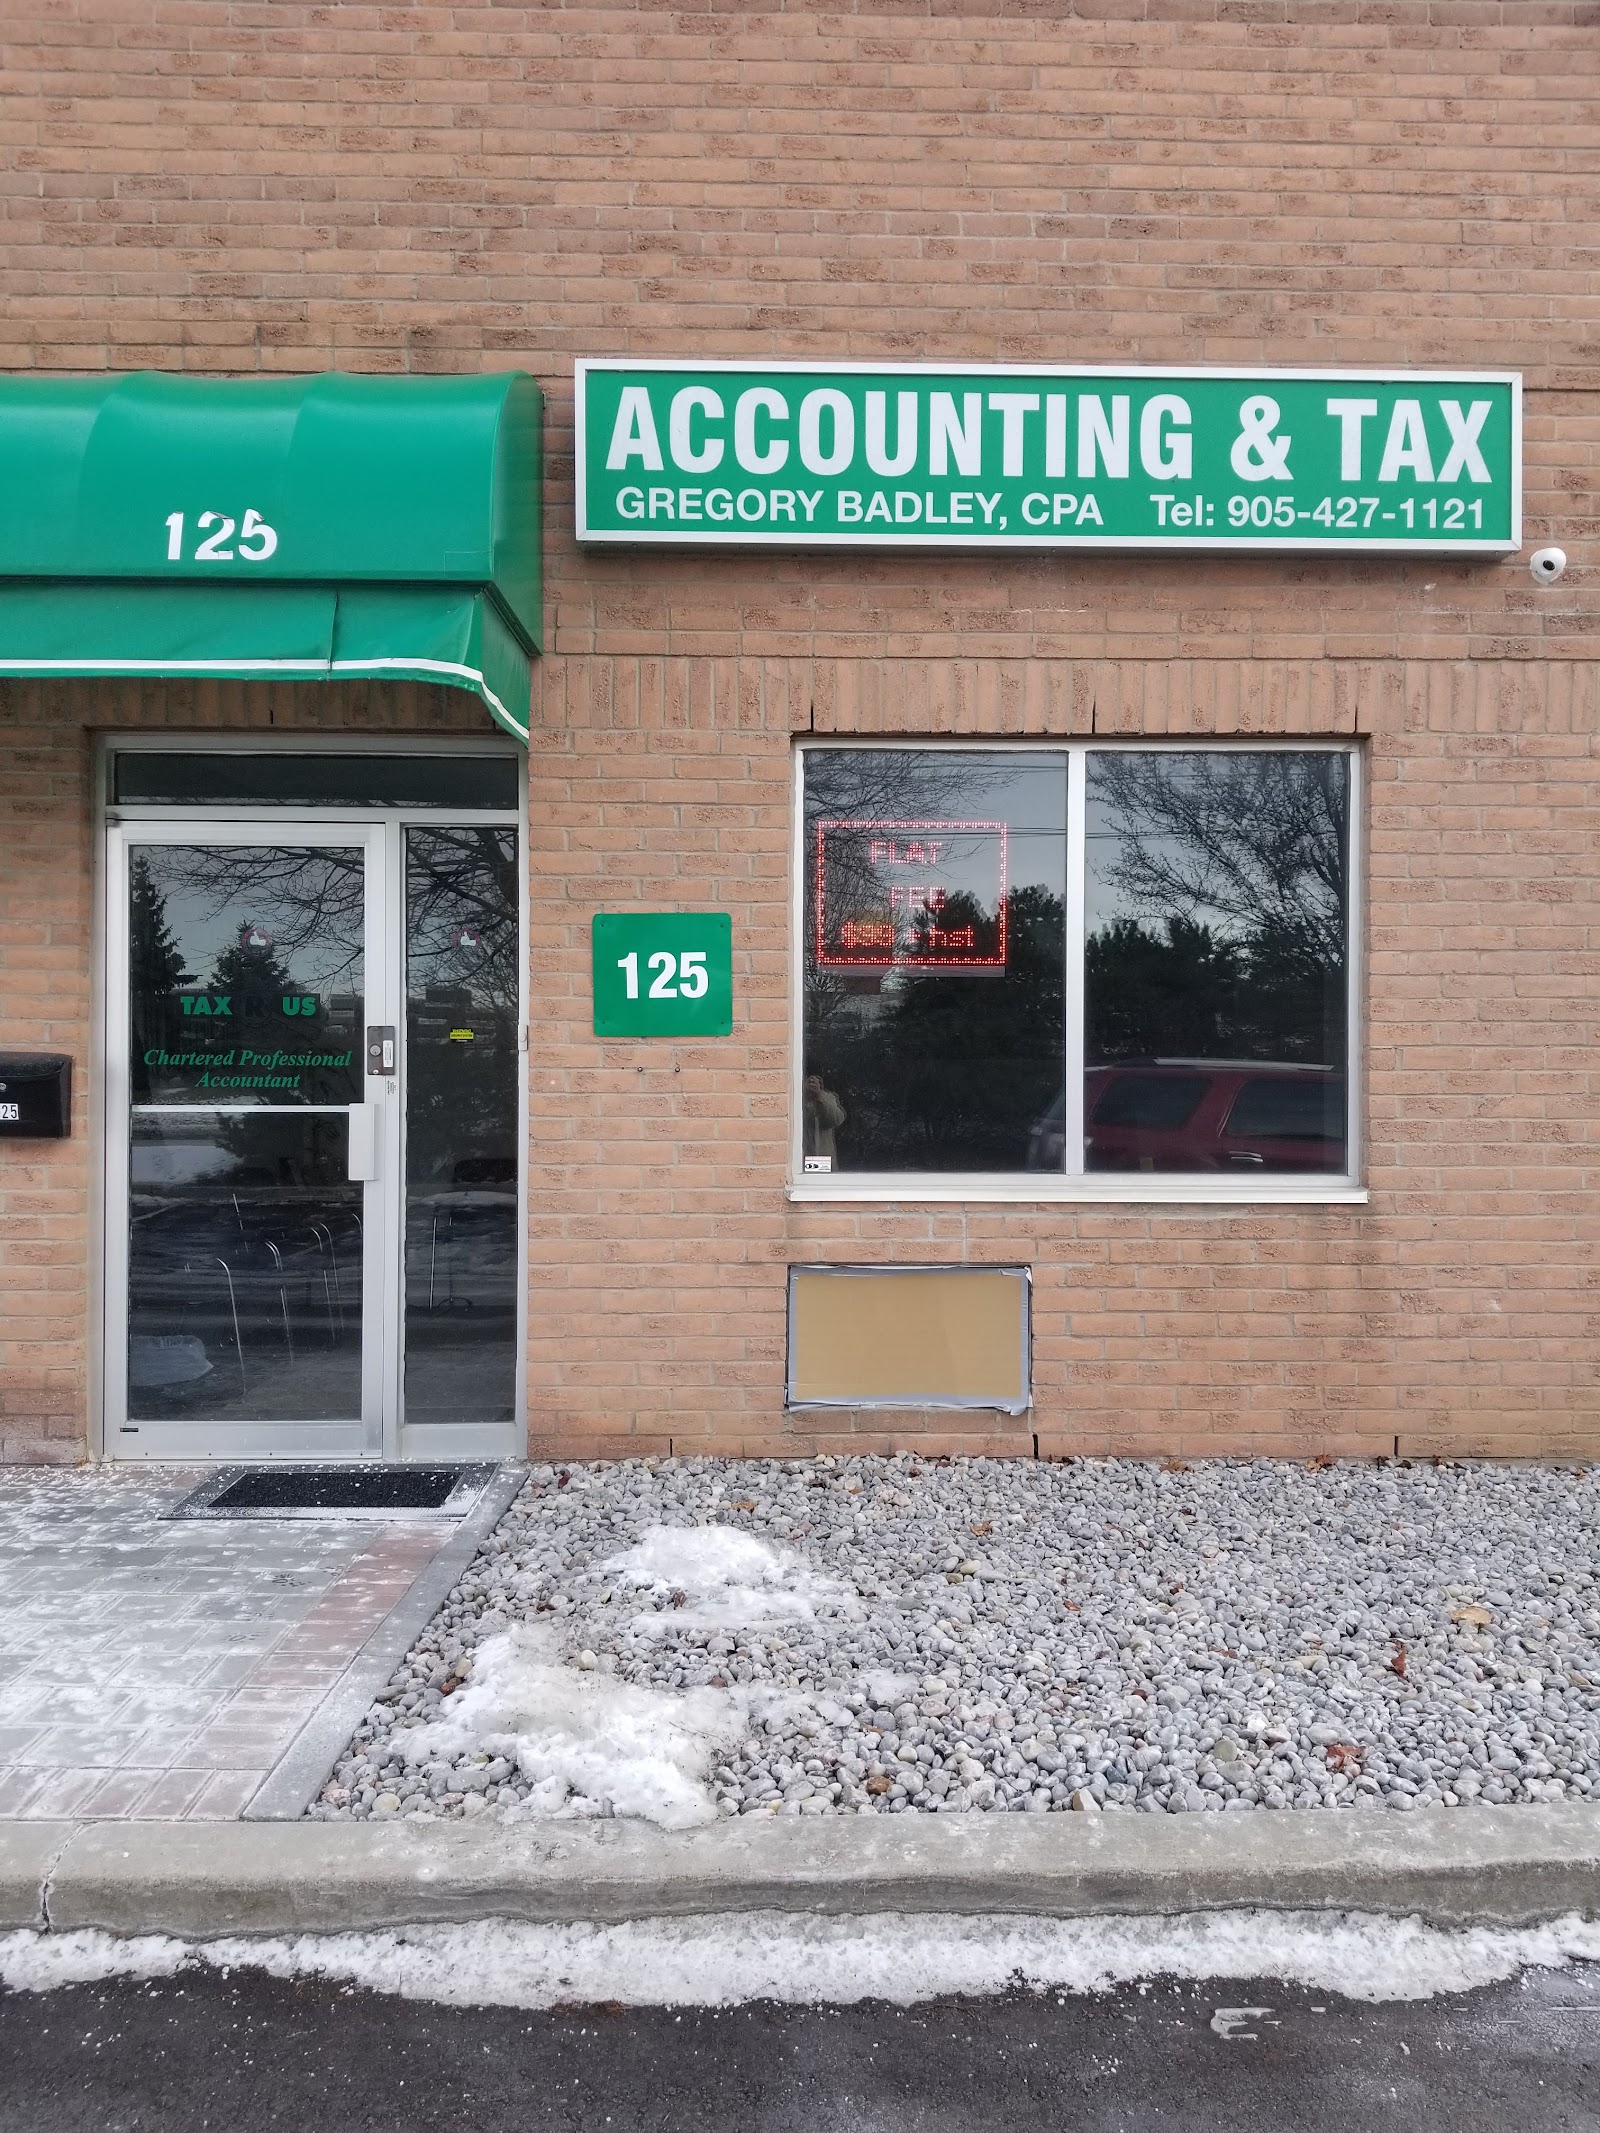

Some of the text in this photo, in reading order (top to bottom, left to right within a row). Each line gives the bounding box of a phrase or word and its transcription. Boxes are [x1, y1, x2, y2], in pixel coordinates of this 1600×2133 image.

[606, 386, 1493, 483] ACCOUNTING & TAX
[615, 486, 1104, 531] GREGORY BADLEY, CPA
[1150, 494, 1483, 529] Tel: 905-427-1121
[165, 508, 278, 561] 125
[870, 841, 943, 865] FLAT
[891, 886, 945, 908] FEE
[929, 925, 973, 947] hst
[617, 951, 709, 999] 125
[179, 995, 233, 1015] TAX
[282, 996, 317, 1016] US
[143, 1048, 353, 1071] Chartered Professional
[196, 1069, 301, 1088] Accountant
